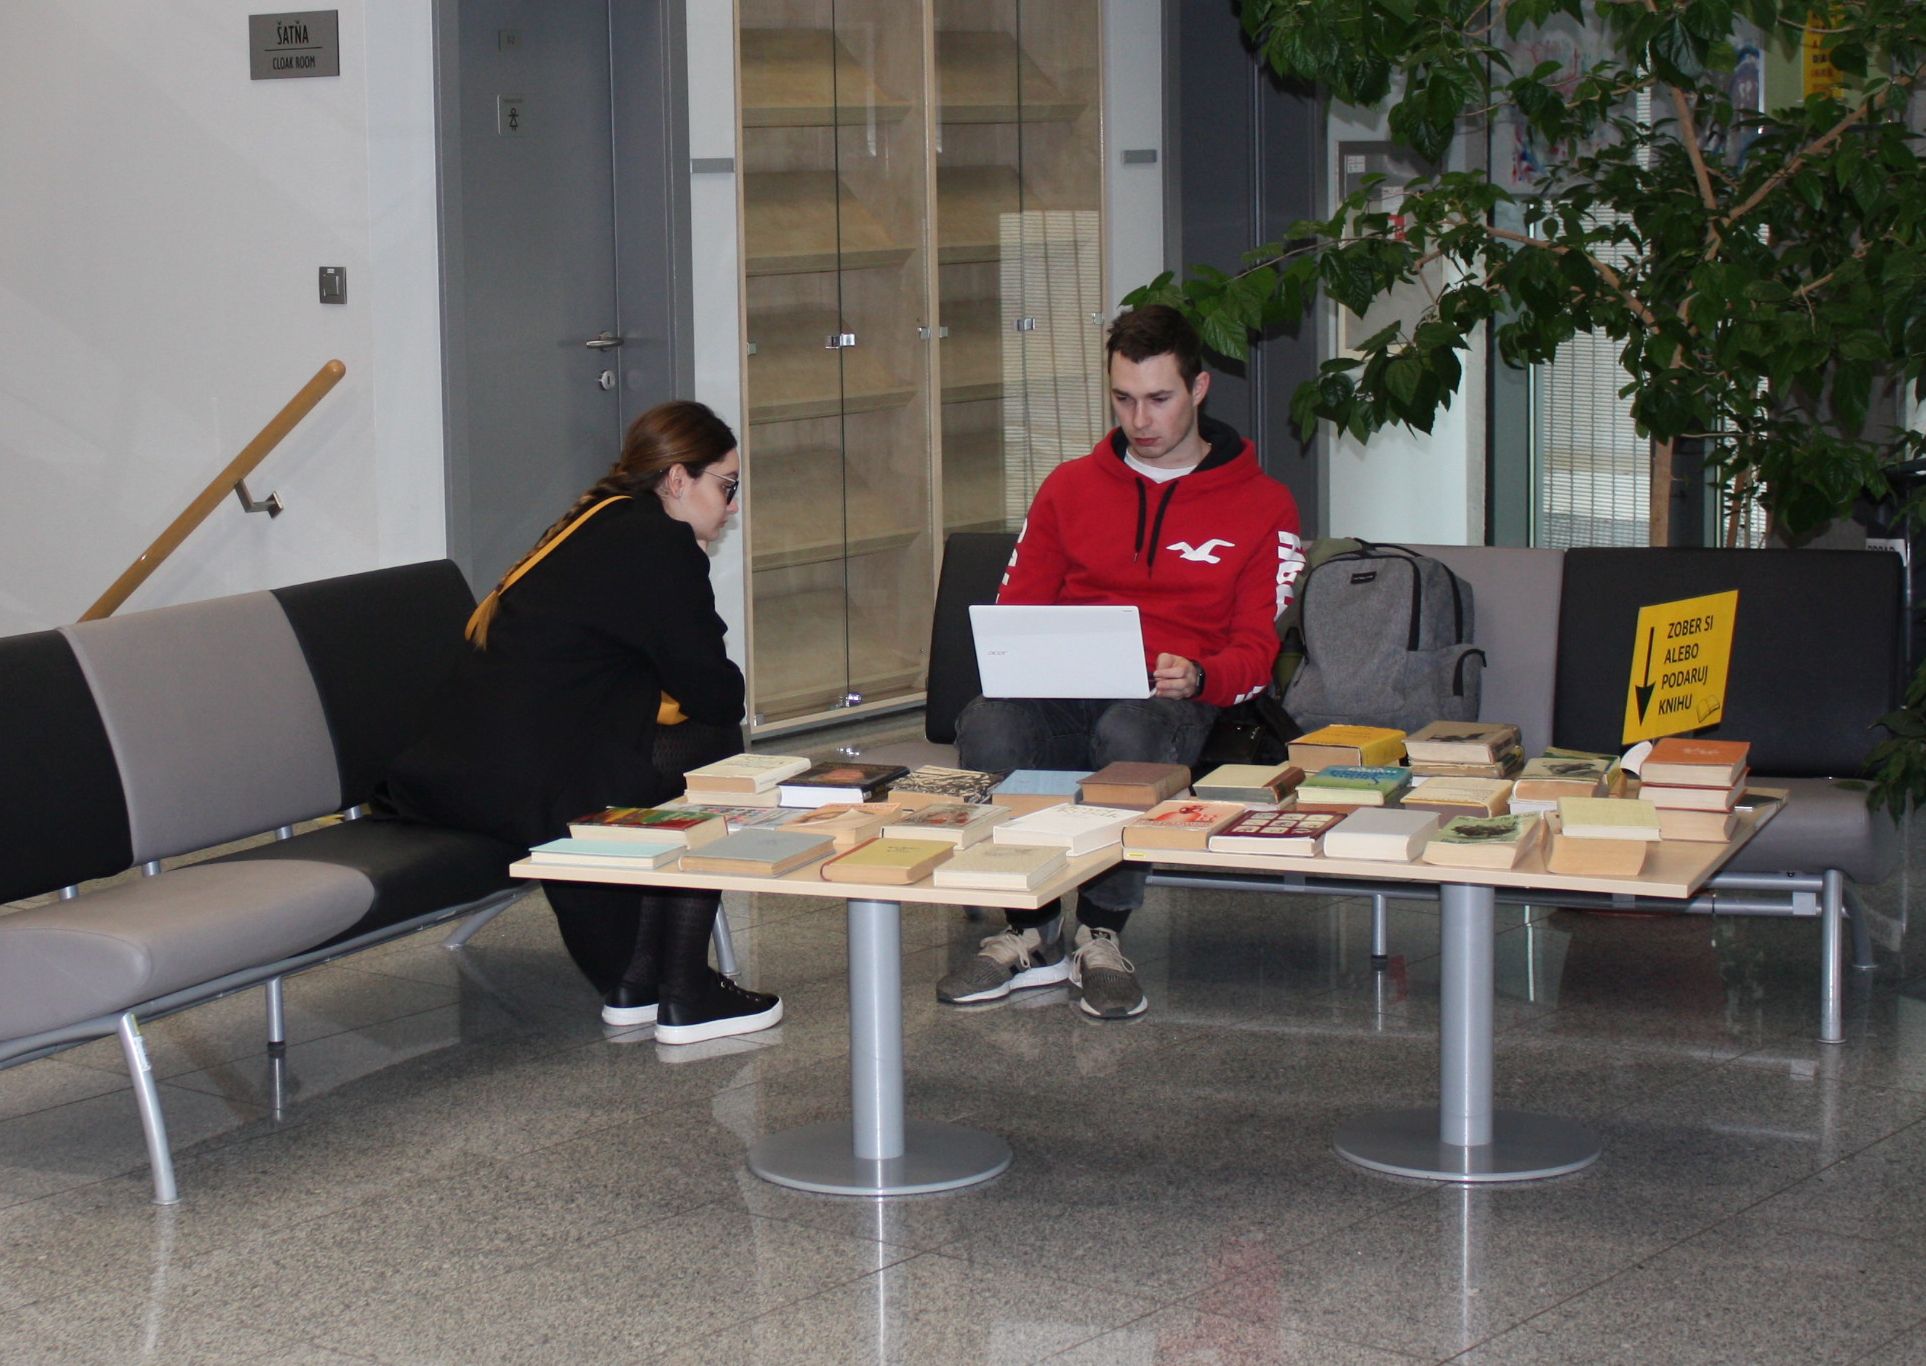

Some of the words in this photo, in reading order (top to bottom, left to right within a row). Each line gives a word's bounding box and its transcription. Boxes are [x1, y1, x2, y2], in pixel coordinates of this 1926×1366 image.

[277, 20, 309, 45] ŠATŇA
[272, 56, 294, 70] CLOAK
[295, 55, 316, 69] ROOM
[1667, 617, 1702, 639] ZOBER
[1703, 615, 1714, 632] SI
[1664, 643, 1700, 664] ALEBO
[1661, 665, 1709, 689] PODARUJ
[1658, 694, 1693, 715] KNIHU
